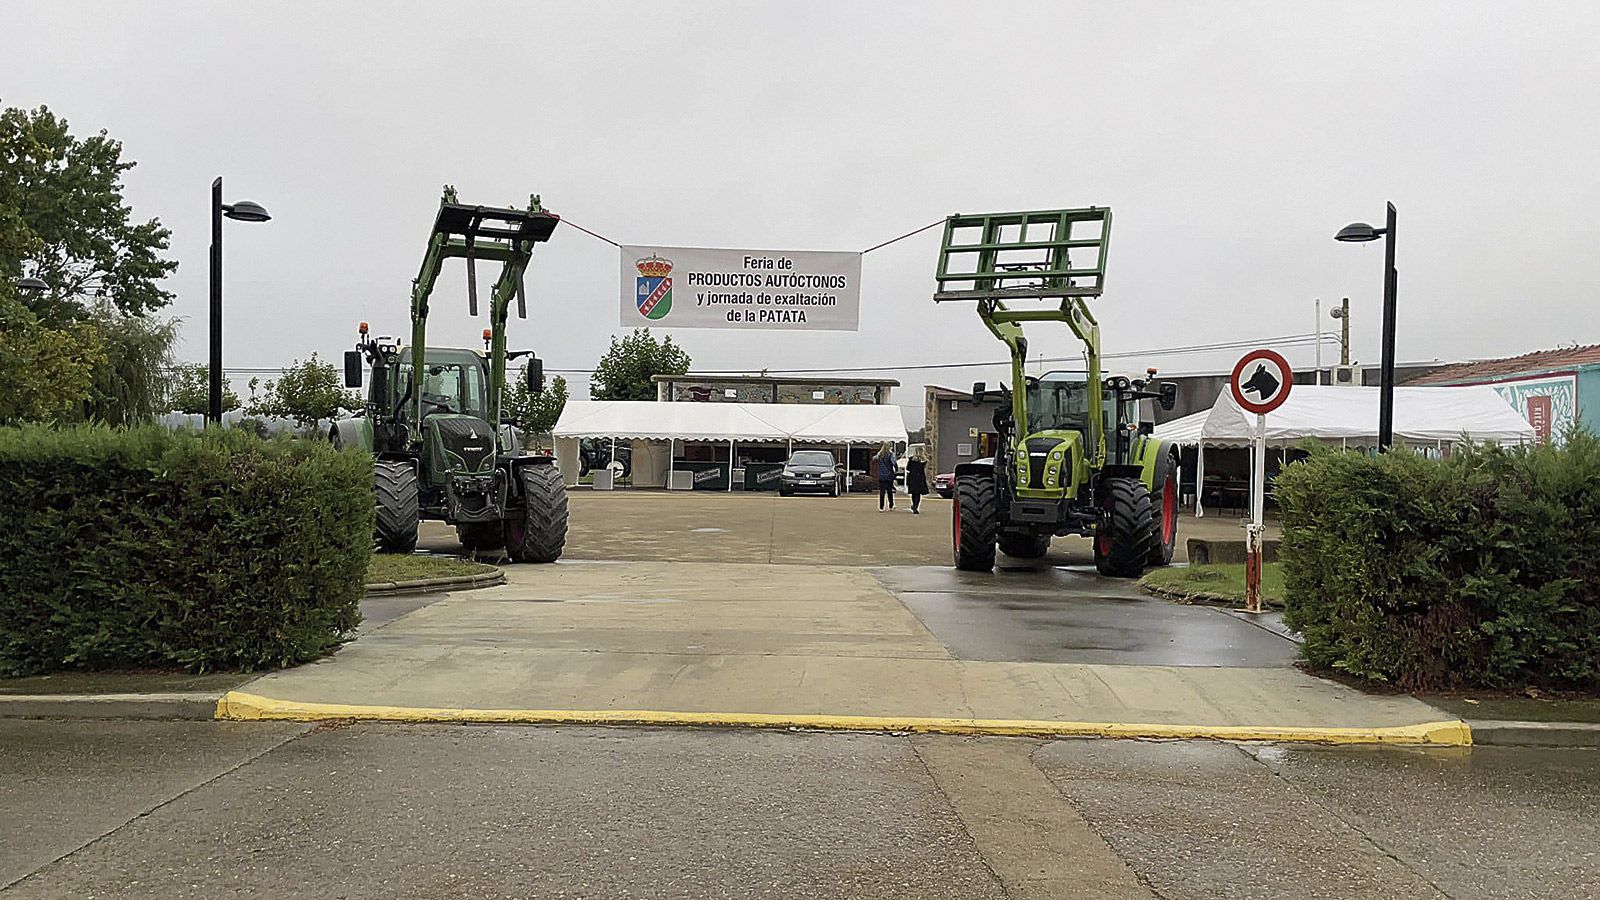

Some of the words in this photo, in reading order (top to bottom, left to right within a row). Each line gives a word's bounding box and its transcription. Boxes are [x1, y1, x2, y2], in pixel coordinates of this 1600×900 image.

[744, 257, 773, 269] Feria
[778, 258, 792, 269] de
[688, 273, 762, 286] PRODUCTOS
[765, 273, 845, 288] AUTÓCTONOS
[697, 294, 704, 305] y
[707, 291, 753, 306] jornada
[757, 293, 771, 304] de
[775, 293, 836, 305] exaltación
[727, 310, 741, 321] de
[745, 310, 755, 321] la
[760, 310, 806, 322] PATATA
